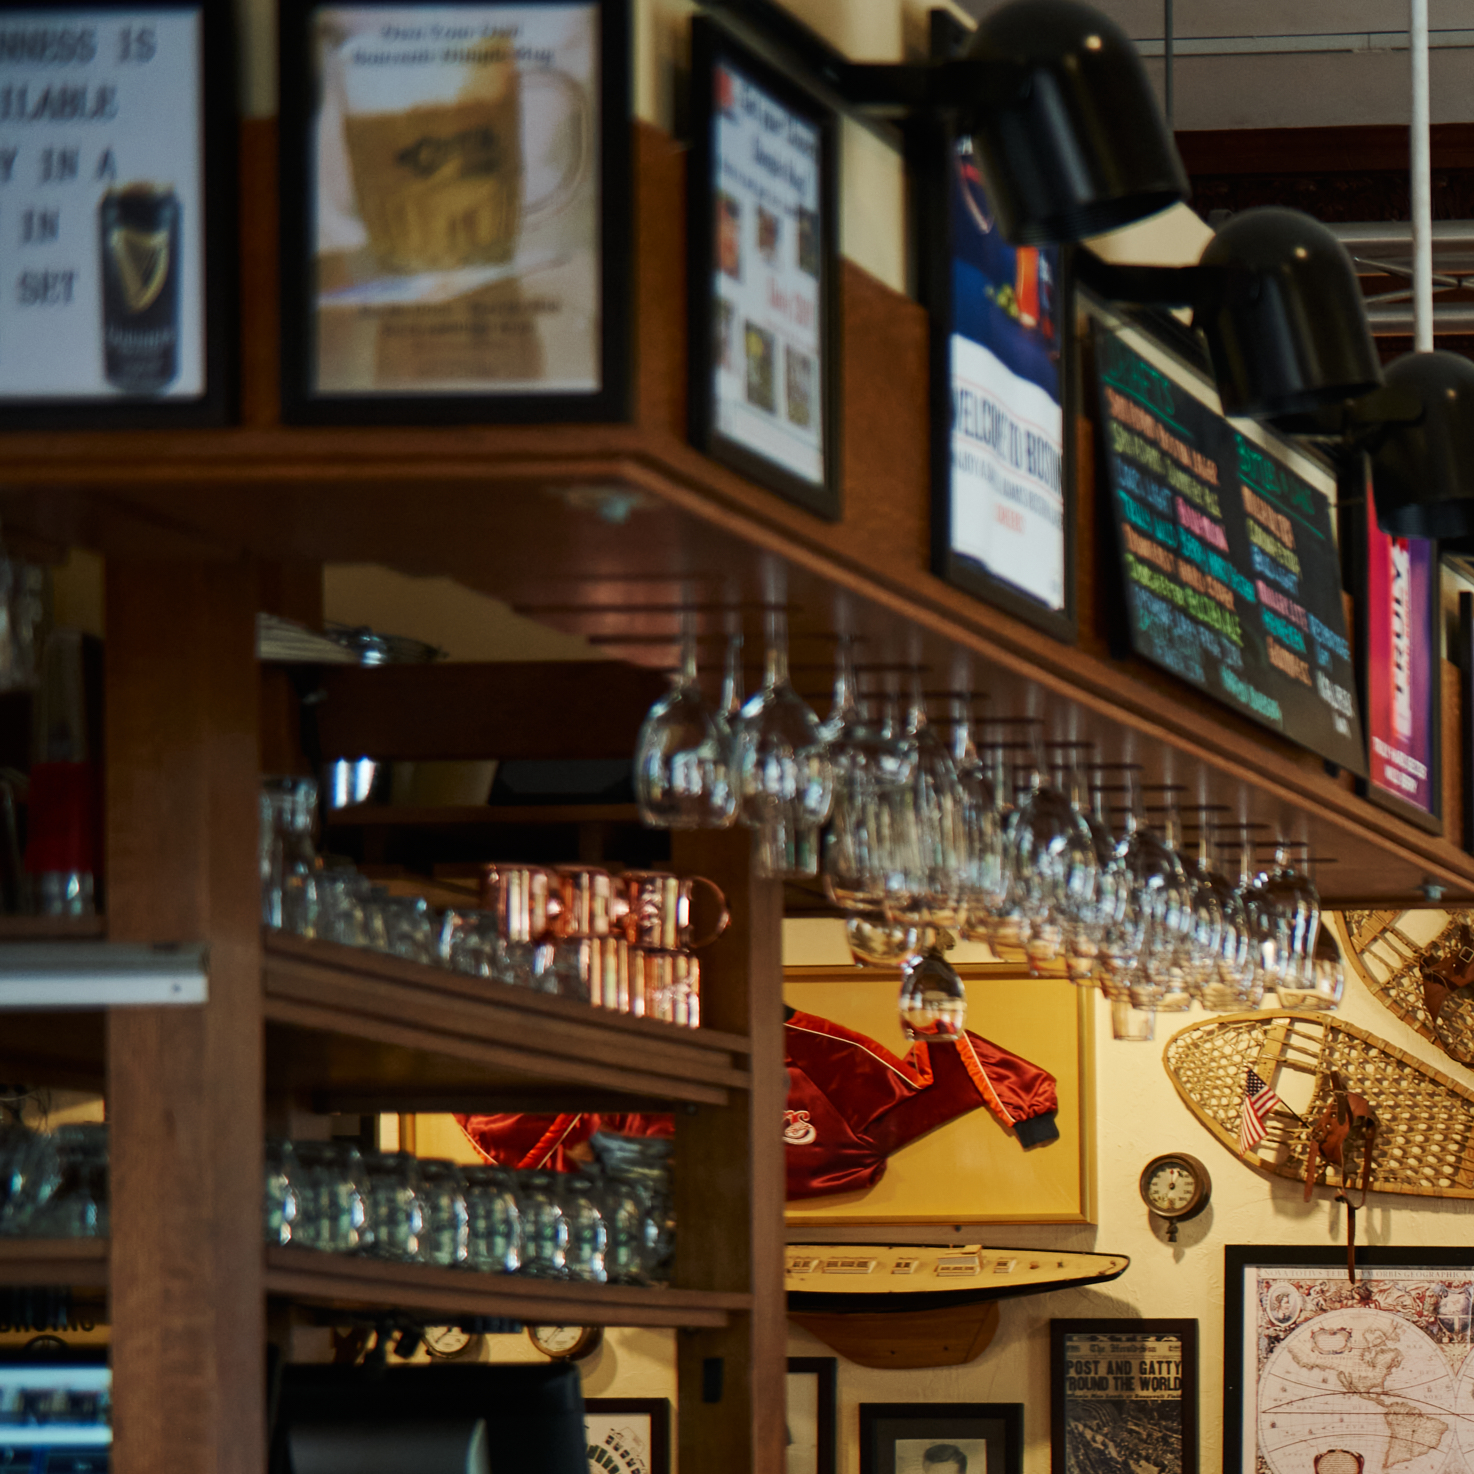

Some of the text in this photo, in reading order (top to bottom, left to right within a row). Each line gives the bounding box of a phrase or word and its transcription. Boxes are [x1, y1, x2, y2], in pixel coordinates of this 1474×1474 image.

[1065, 1360, 1181, 1375] POST AND GATTY
[1113, 1376, 1135, 1391] THE
[1139, 1376, 1182, 1392] WORLD
